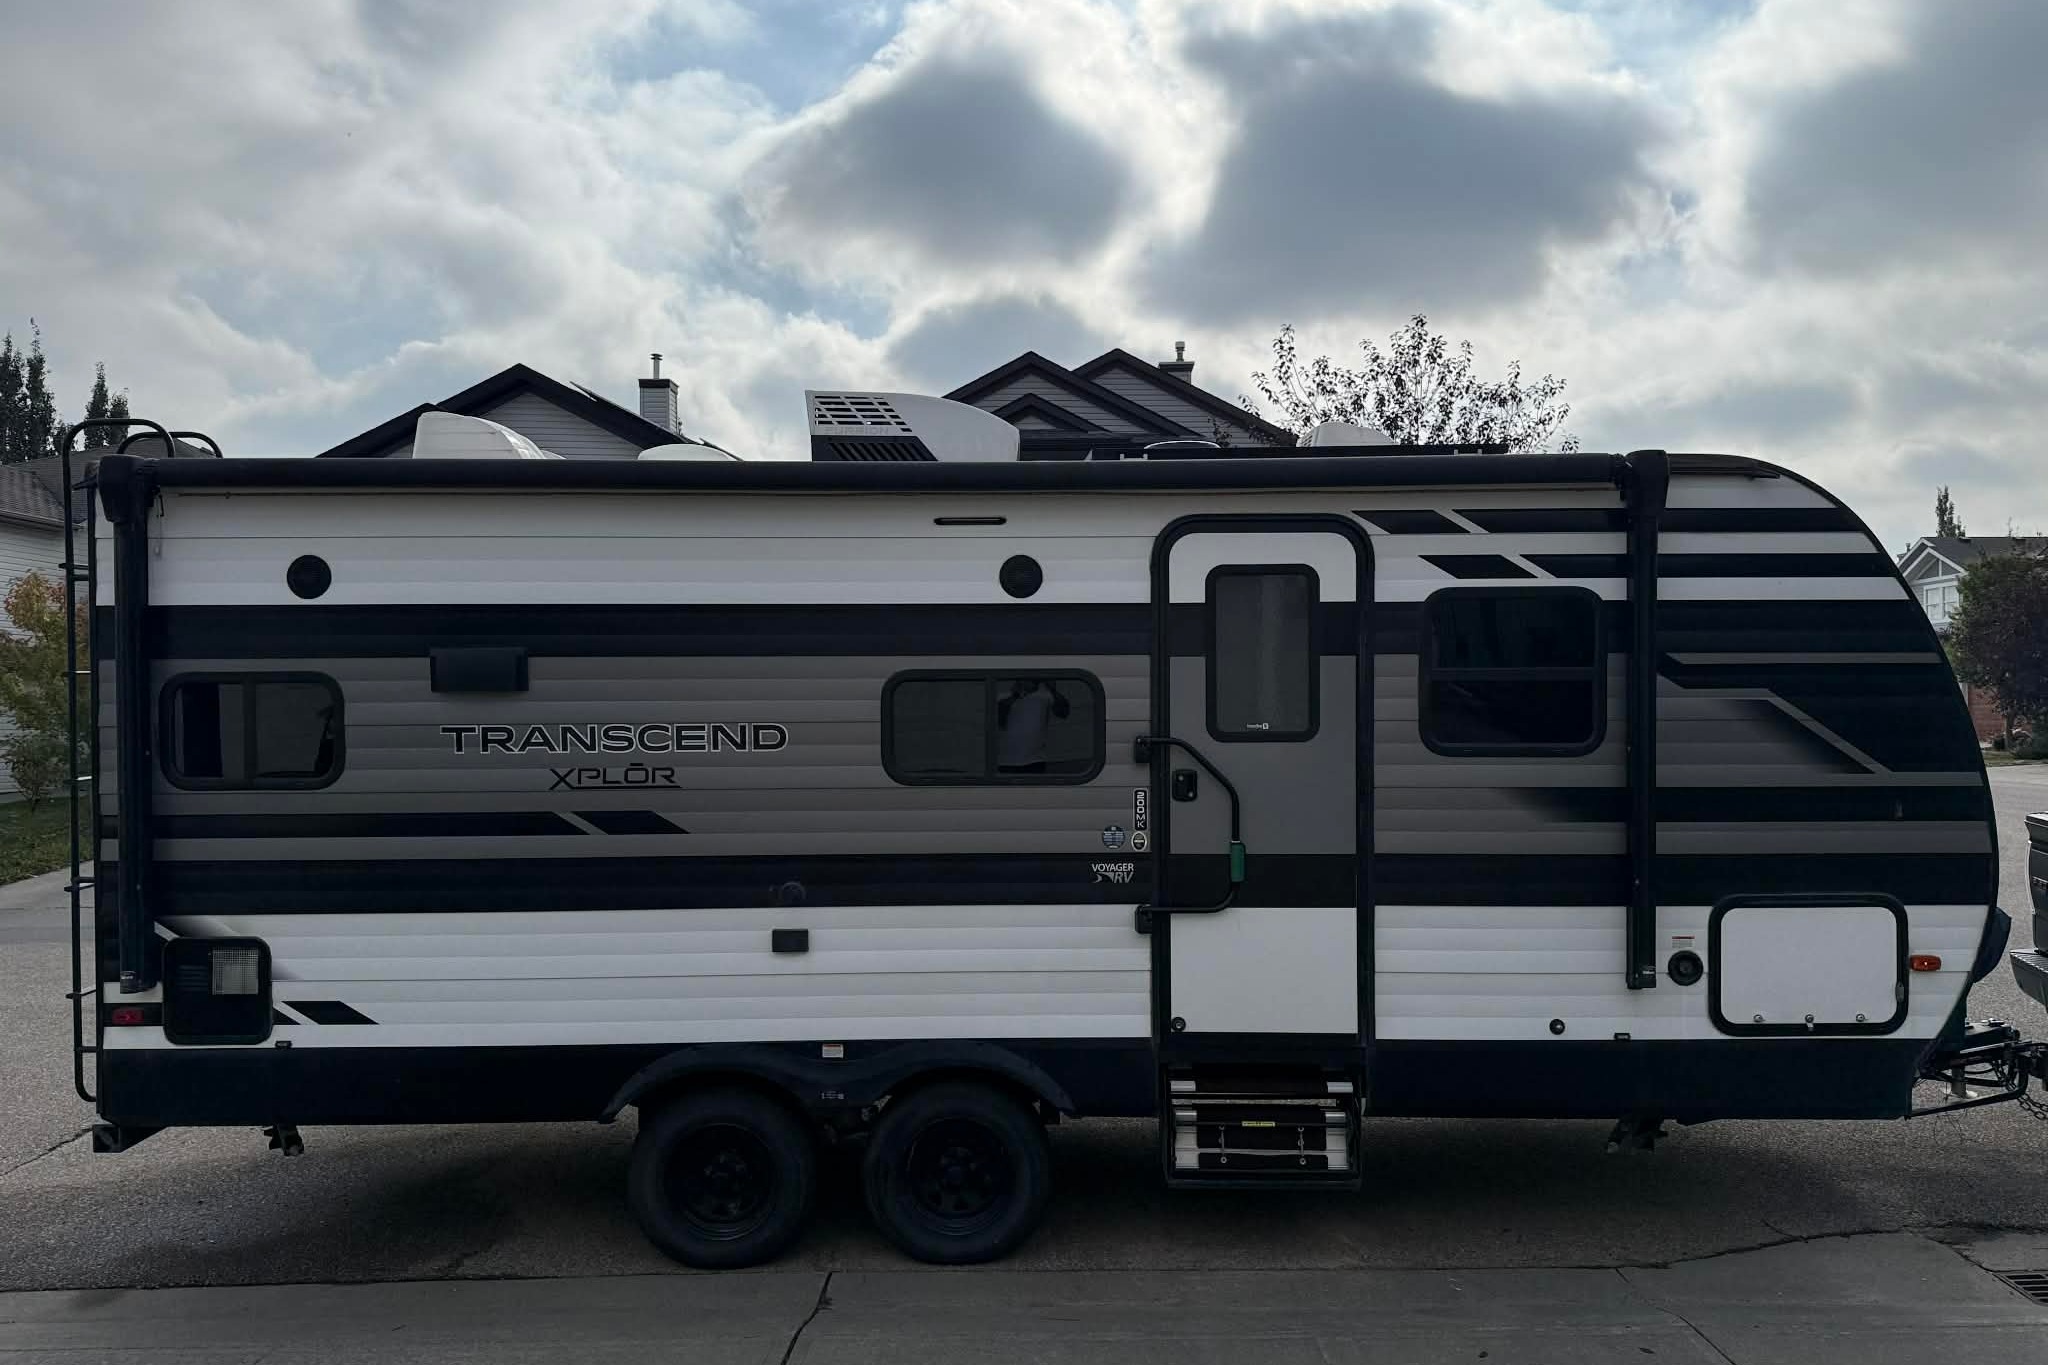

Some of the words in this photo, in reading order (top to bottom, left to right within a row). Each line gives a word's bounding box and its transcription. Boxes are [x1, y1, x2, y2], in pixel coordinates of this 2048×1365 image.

[440, 723, 789, 755] TRANSCEND
[1136, 791, 1146, 828] 200MK
[1091, 863, 1135, 872] VOYAGER
[1113, 871, 1134, 884] RV
